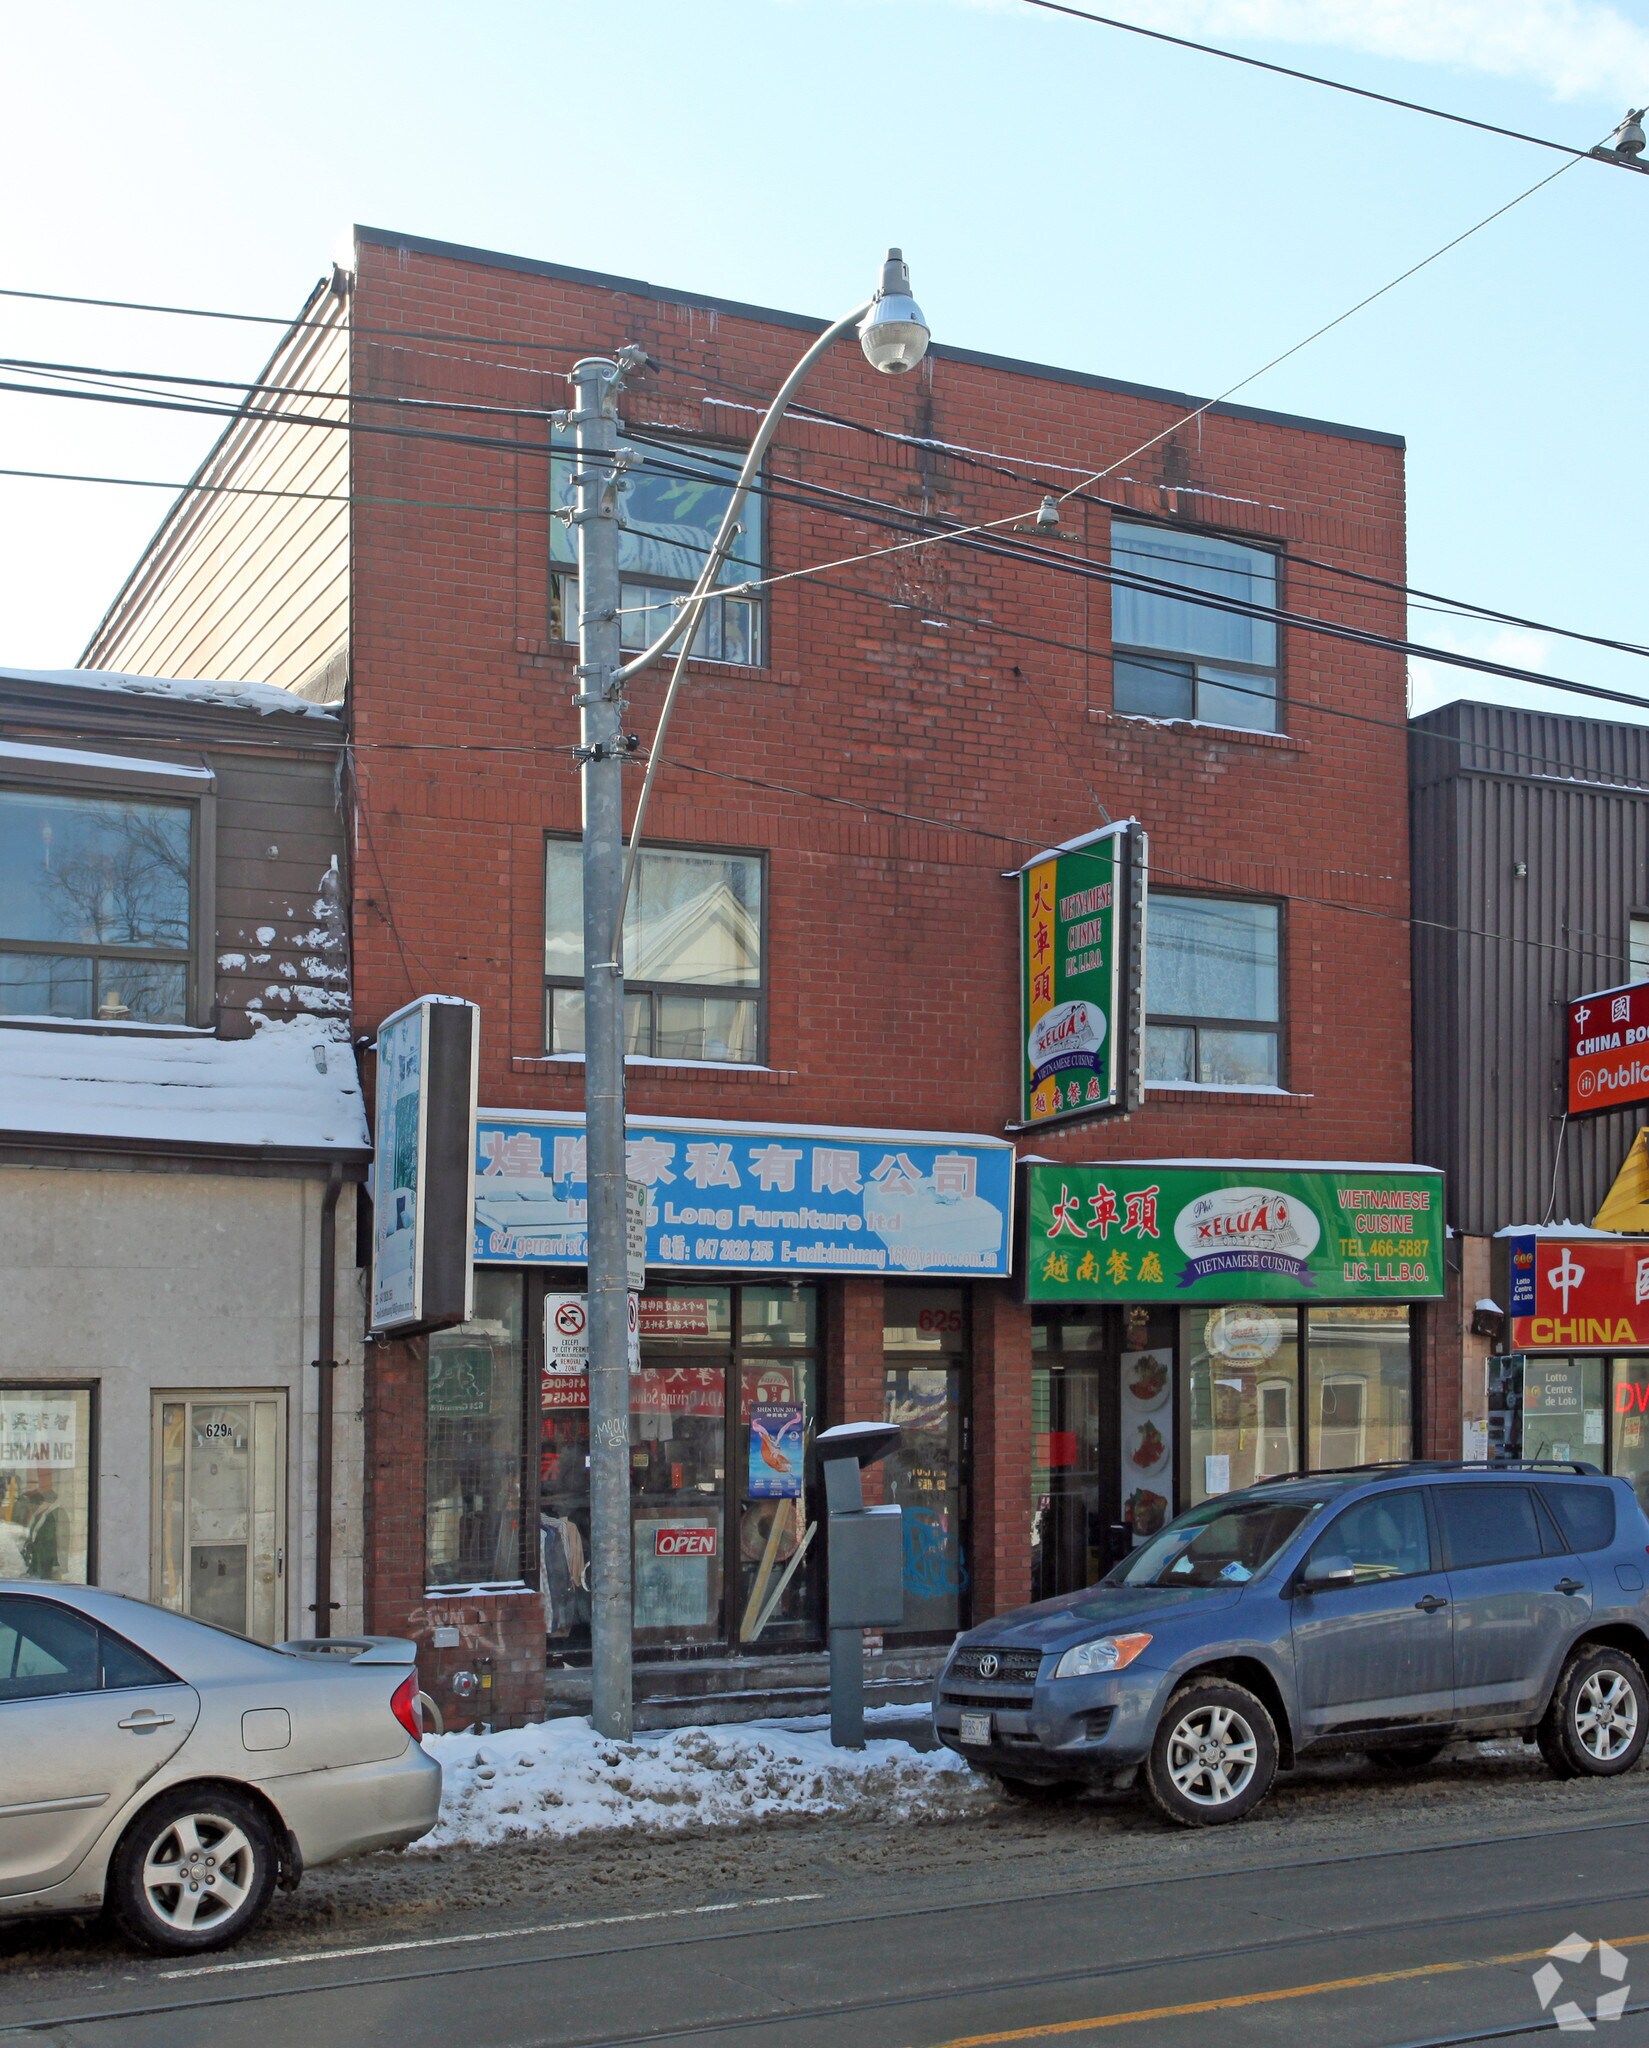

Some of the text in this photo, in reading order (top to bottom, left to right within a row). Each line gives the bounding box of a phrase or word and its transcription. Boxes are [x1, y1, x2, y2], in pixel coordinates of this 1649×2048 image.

[1059, 882, 1112, 922] VIETNAMESE
[1032, 875, 1053, 1004] 火車頭
[1067, 917, 1102, 952] CUISINE
[1574, 995, 1631, 1035] 中國
[1576, 1032, 1621, 1056] CHINA
[1037, 1054, 1095, 1081] VIETNAMESE CUISINE
[1597, 1060, 1649, 1092] Public
[1034, 1076, 1101, 1113] 越南餐廳
[1337, 1189, 1430, 1210] VIETNAMESE
[664, 1202, 733, 1230] Long
[738, 1205, 862, 1231] Furniture
[1047, 1184, 1161, 1240] 火車頭
[1355, 1213, 1413, 1234] CUISINE
[489, 1231, 513, 1251] 627
[514, 1231, 567, 1258] gerrard
[568, 1236, 583, 1255] st
[720, 1239, 750, 1261] 2828
[751, 1240, 774, 1261] 255
[1339, 1239, 1429, 1258] TEL.466-5887
[1042, 1249, 1164, 1285] 越南餐廳
[1194, 1254, 1300, 1277] VIETNAMESE CUISINE
[1343, 1263, 1429, 1282] LIC. L.L.B.O.
[1514, 1285, 1532, 1293] Centre
[1521, 1293, 1533, 1301] Loto
[919, 1309, 962, 1332] 625
[1531, 1318, 1638, 1344] CHINA
[1545, 1372, 1568, 1383] Lotto
[1545, 1384, 1574, 1395] Centre
[1545, 1396, 1577, 1406] de Loto
[205, 1423, 233, 1439] 629A
[54, 1442, 73, 1460] NG
[659, 1536, 714, 1554] OPEN
